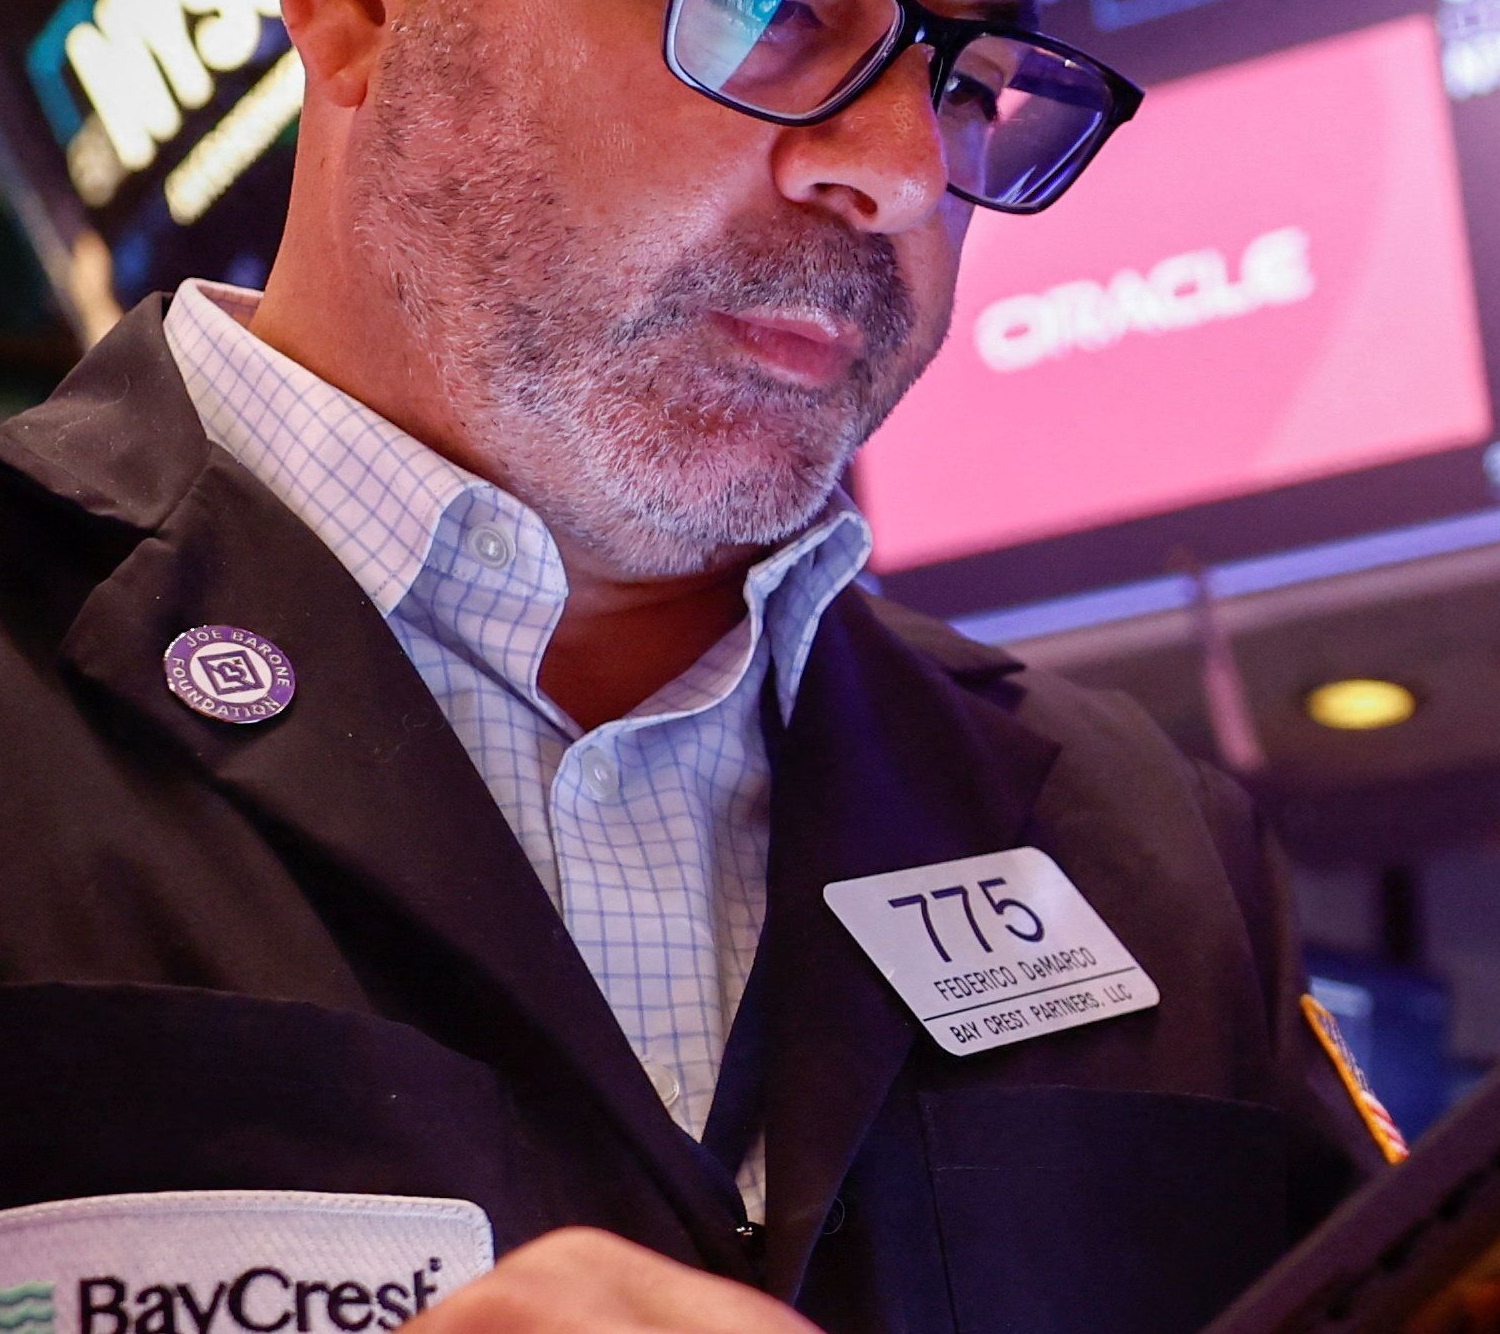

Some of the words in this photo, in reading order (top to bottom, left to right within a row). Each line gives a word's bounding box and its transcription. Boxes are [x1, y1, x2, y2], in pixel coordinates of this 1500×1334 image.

[975, 225, 1315, 372] ORACLE
[170, 656, 281, 718] FOUNDATION
[185, 628, 222, 648] JOE
[229, 630, 291, 688] BARONE
[888, 876, 1045, 963] 775
[933, 966, 1018, 1002] FEDERICO
[1017, 946, 1097, 981] DeMARCO
[949, 1021, 982, 1044] BAY
[983, 1010, 1029, 1037] CREST
[1108, 983, 1134, 1004] LLC
